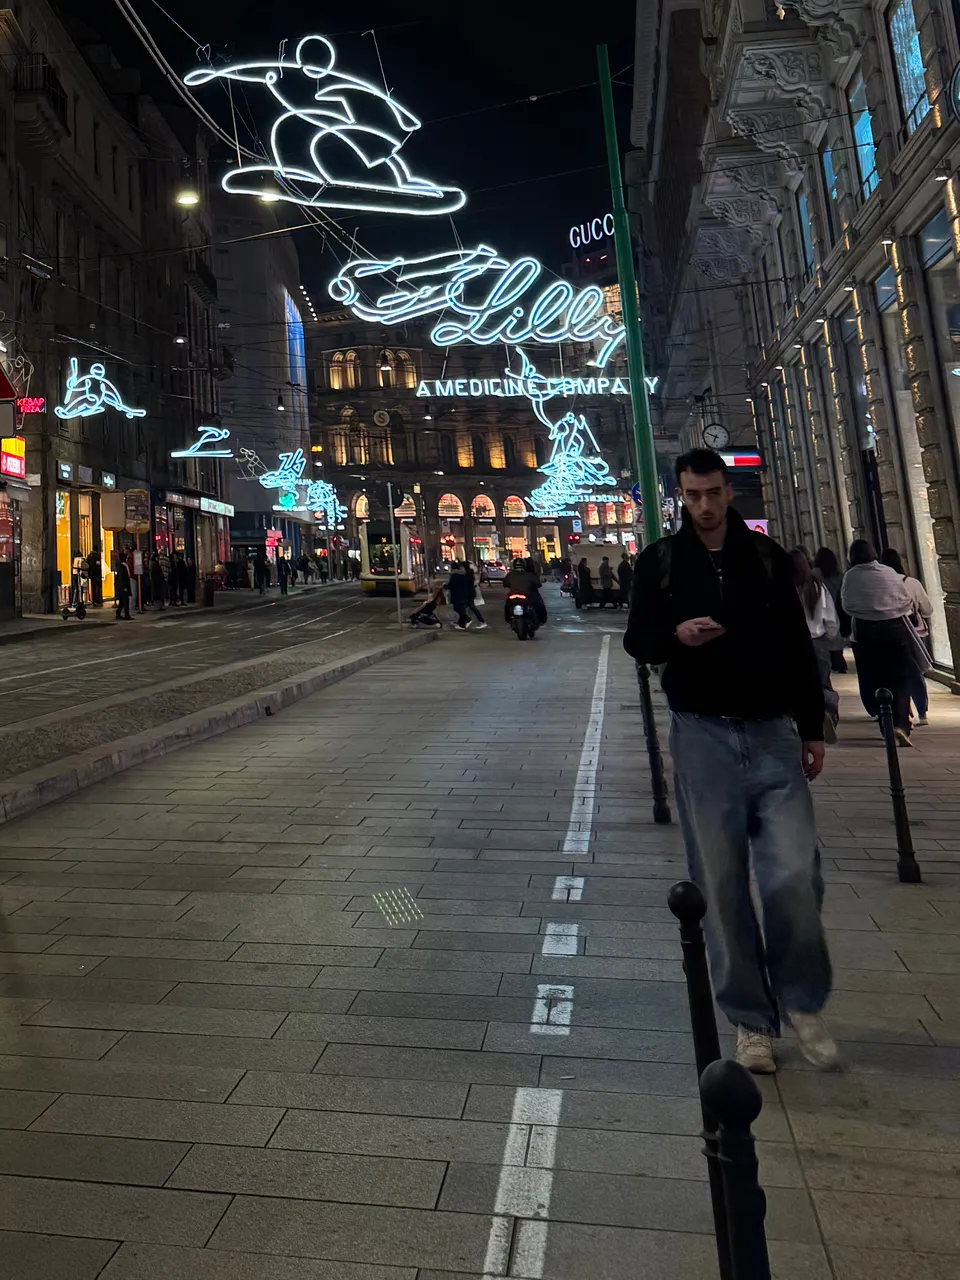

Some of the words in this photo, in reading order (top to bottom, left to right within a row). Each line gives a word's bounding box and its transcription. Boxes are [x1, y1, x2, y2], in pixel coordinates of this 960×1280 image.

[569, 213, 615, 248] GUCC
[431, 257, 627, 368] Lilly
[416, 379, 431, 397] A
[435, 378, 538, 397] MEDICINE
[547, 375, 659, 397] COMPAY
